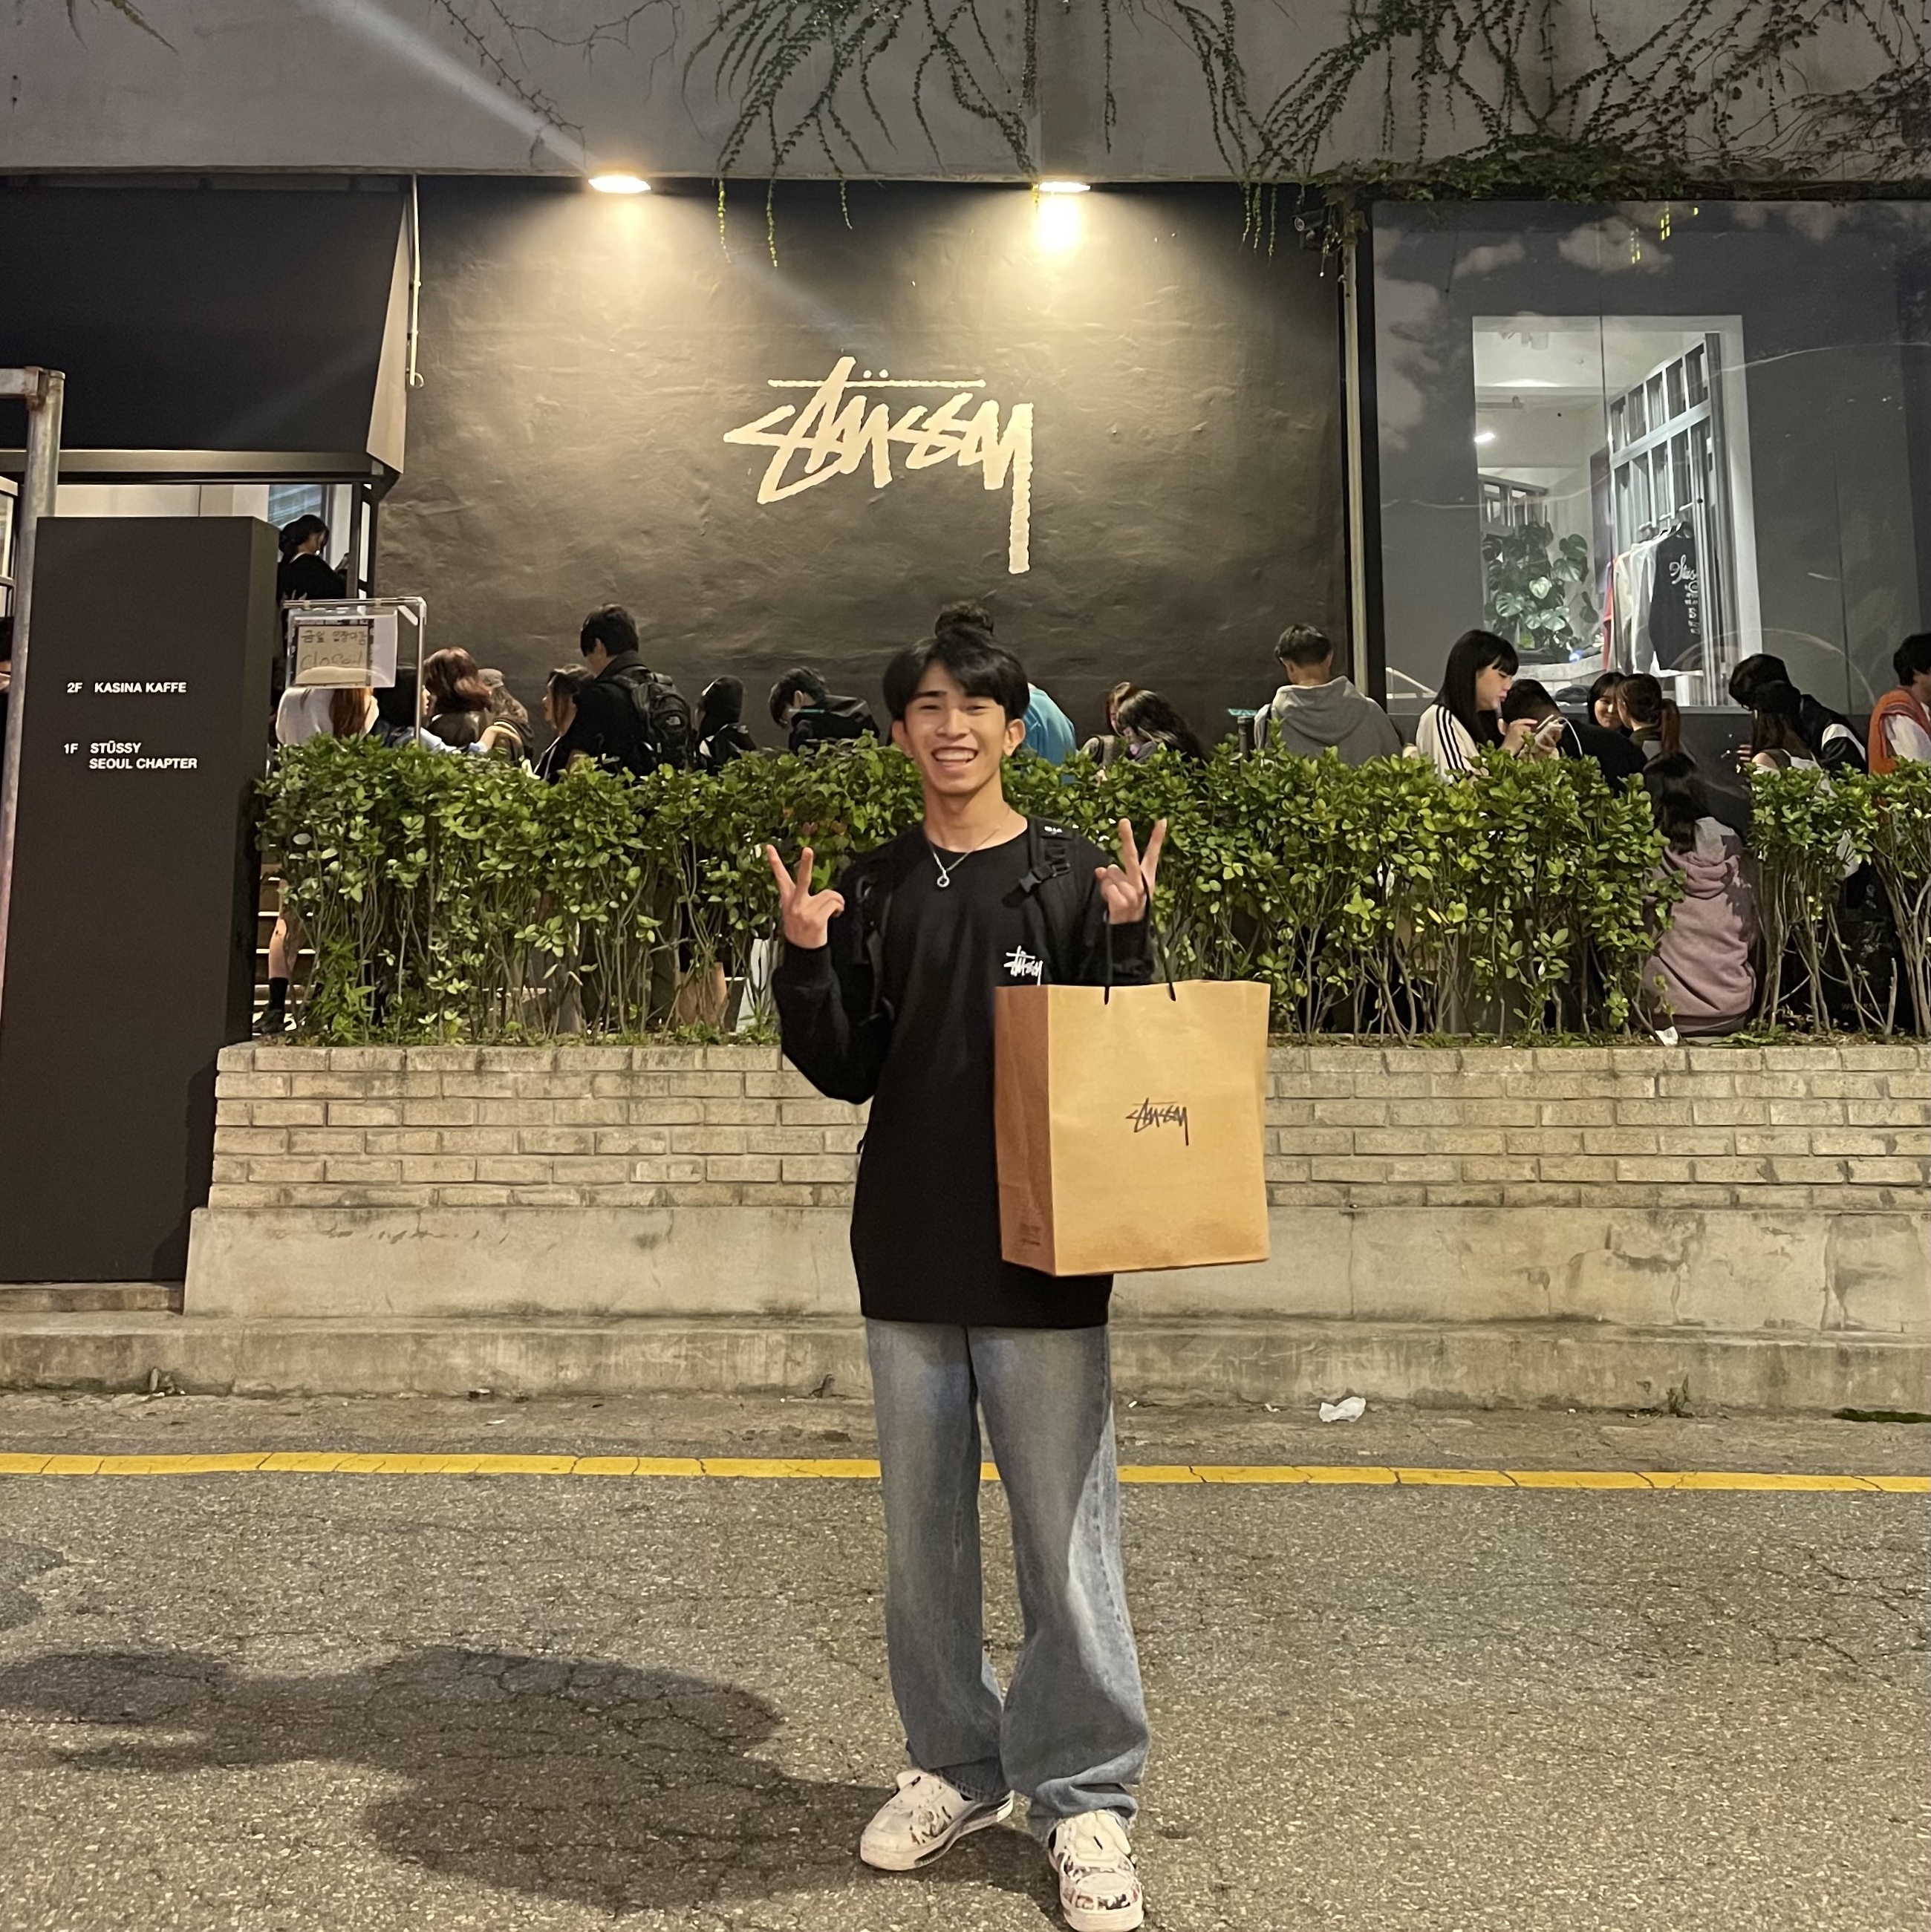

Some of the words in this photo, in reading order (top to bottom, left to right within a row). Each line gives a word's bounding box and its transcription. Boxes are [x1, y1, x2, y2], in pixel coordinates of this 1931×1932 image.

[301, 630, 325, 643] 금일
[67, 682, 83, 693] 2F
[94, 682, 143, 693] KASINA
[146, 682, 187, 693] KAFFE
[64, 743, 79, 754] 1F
[89, 758, 133, 769] SEOUL
[136, 758, 198, 769] CHAPTER
